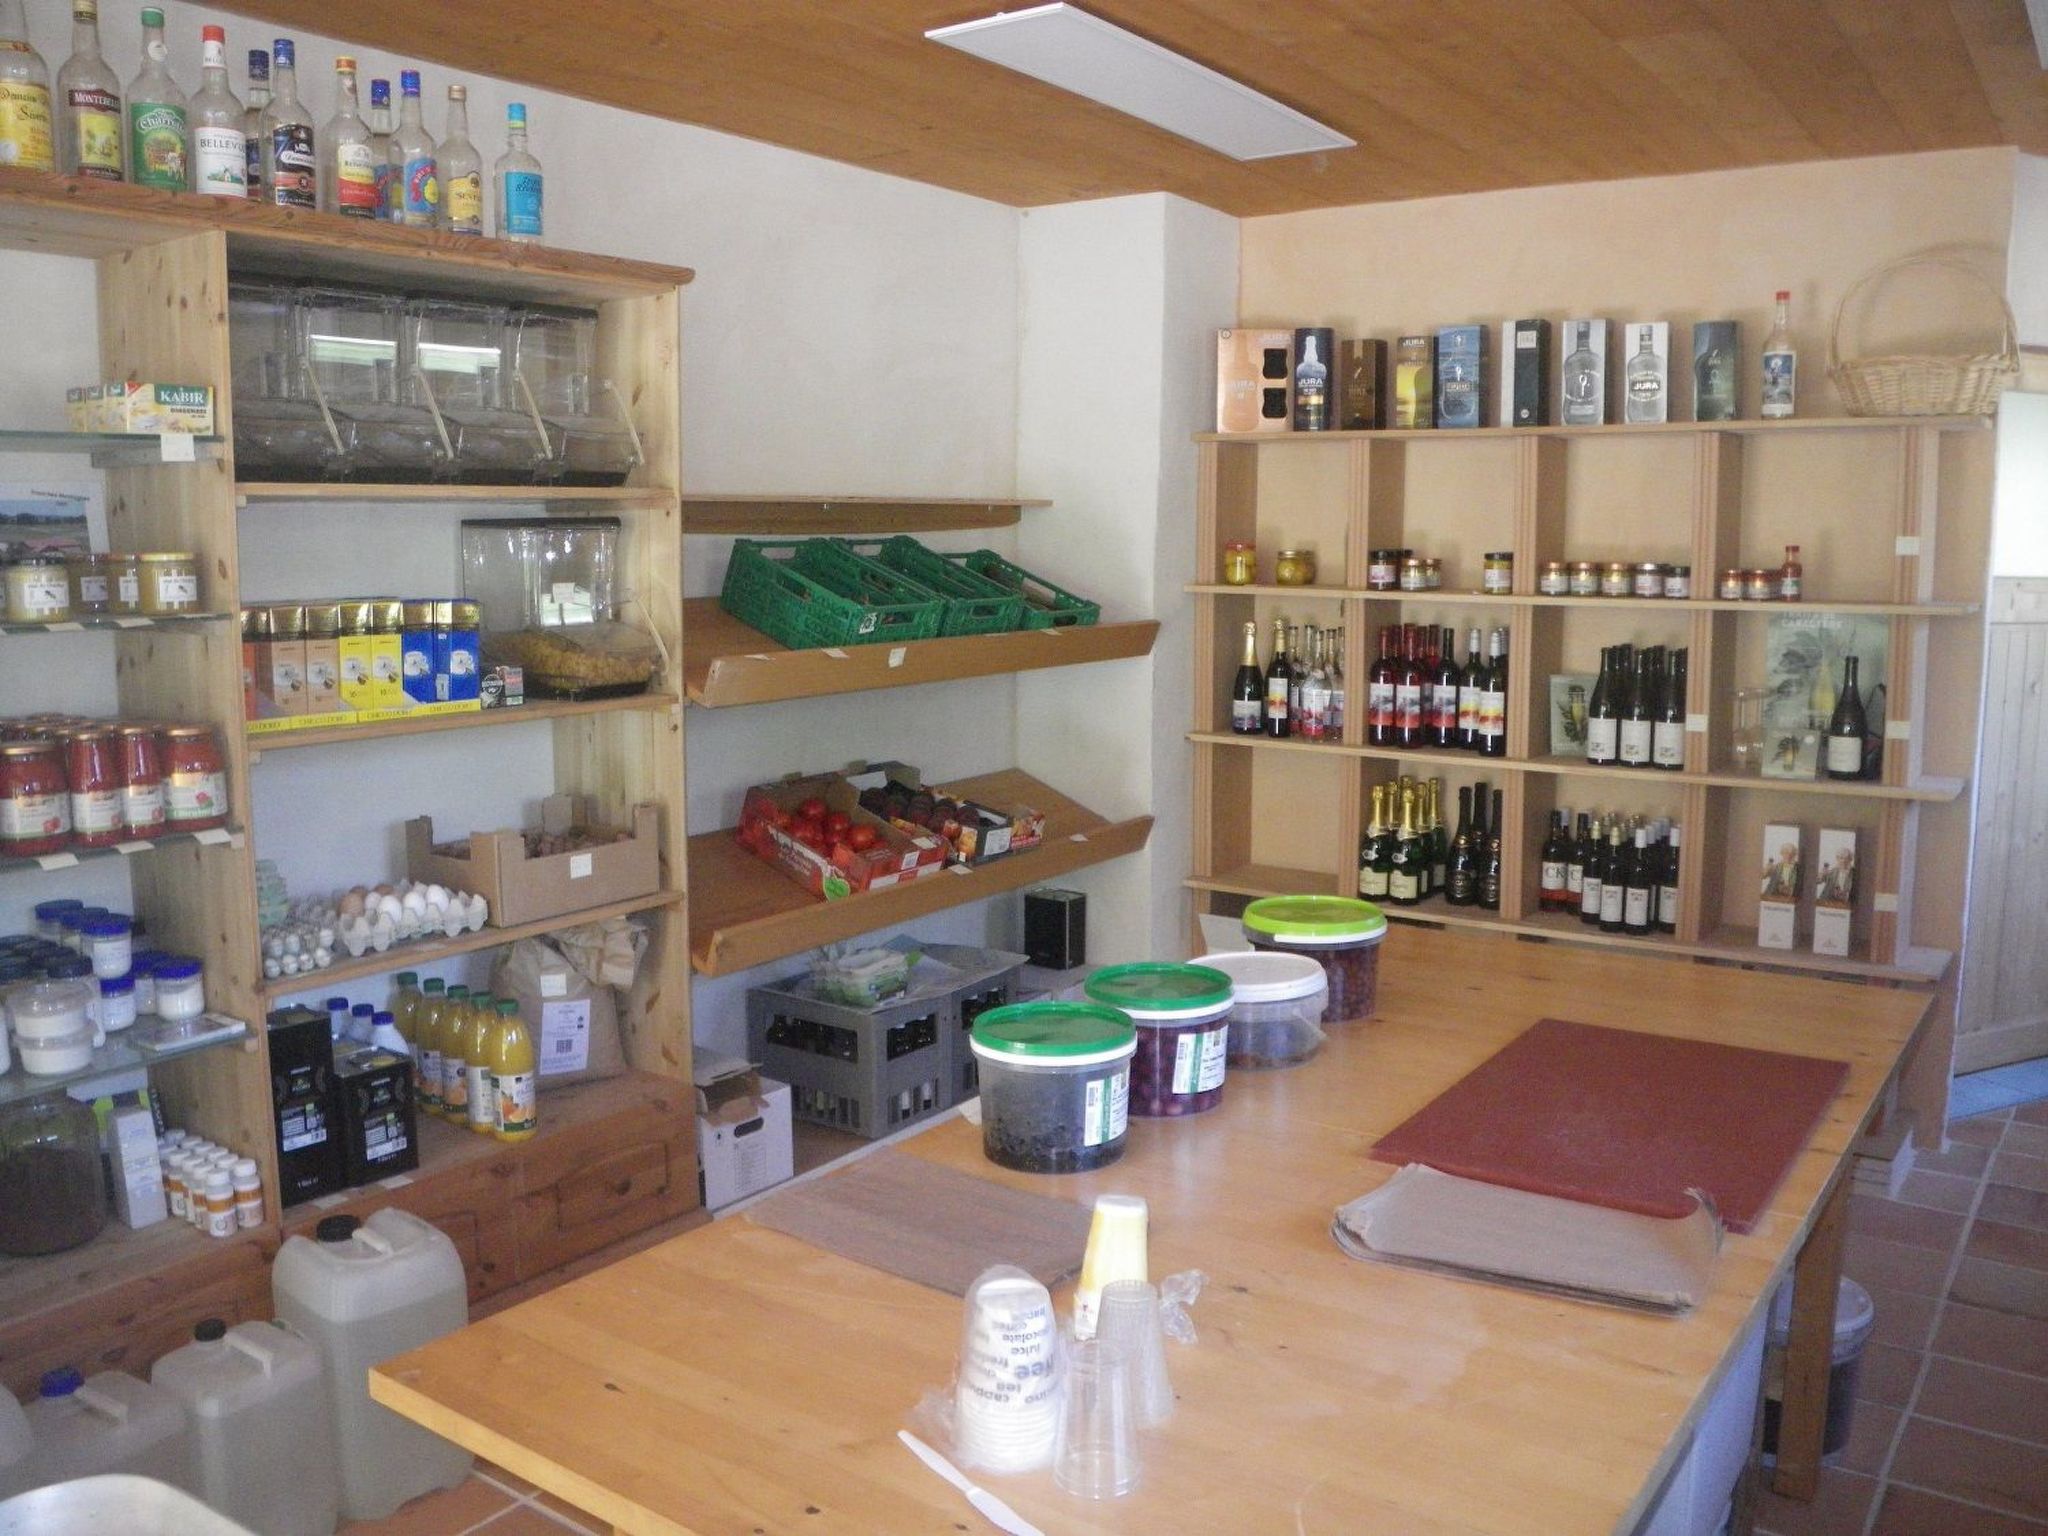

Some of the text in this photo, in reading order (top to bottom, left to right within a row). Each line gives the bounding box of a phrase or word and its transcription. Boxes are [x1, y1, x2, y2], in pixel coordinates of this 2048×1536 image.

[1299, 378, 1323, 386] JURA
[1633, 381, 1659, 390] JURA
[160, 390, 205, 405] KABIR
[1010, 1343, 1040, 1356] juice
